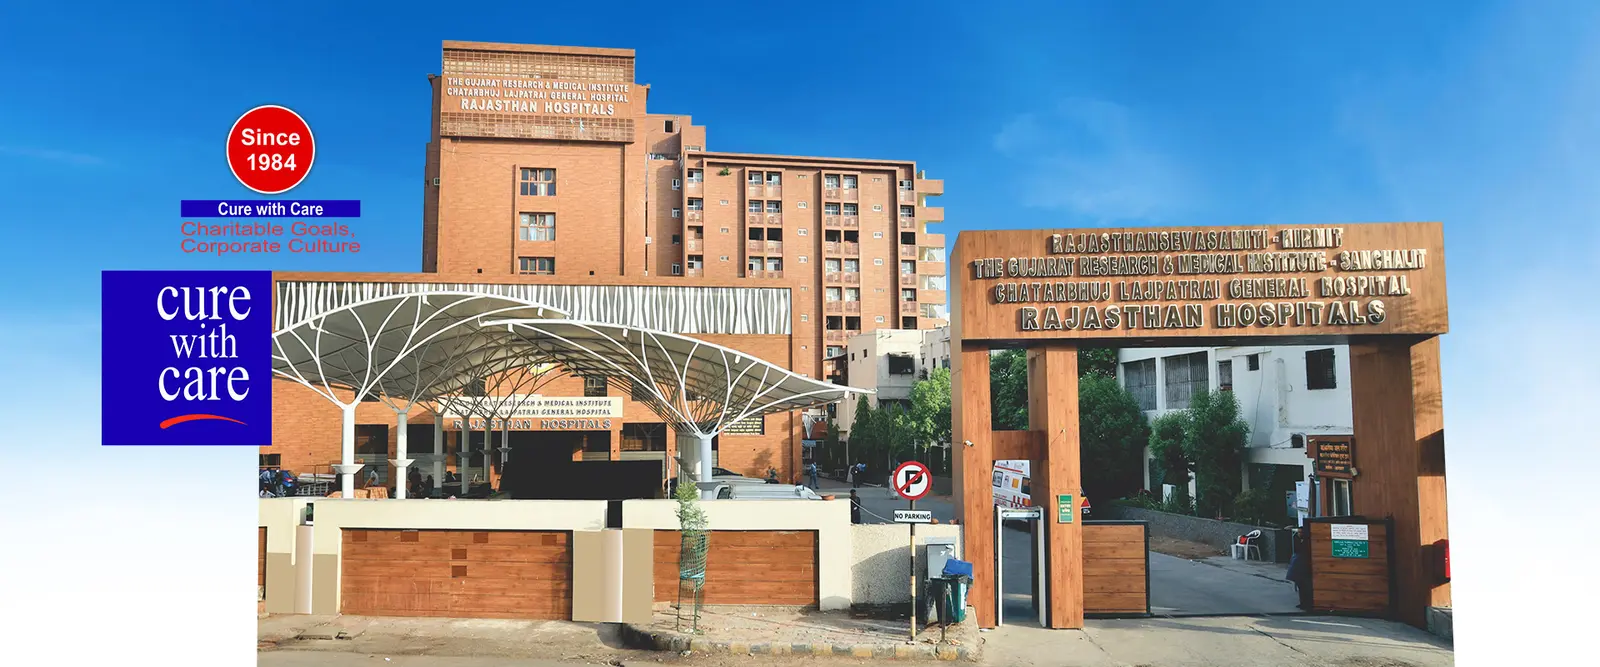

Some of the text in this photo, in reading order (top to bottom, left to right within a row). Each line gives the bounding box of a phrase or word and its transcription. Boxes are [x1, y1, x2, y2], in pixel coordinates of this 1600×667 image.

[447, 77, 629, 93] THE GUJARAT RESEARCH & MEDICAL INSTITUTE
[447, 88, 629, 103] CHATARBHUJ LAJPATRAI GENERAL HOSPITAL
[461, 99, 615, 115] RAJASTHAN HOSPITALS
[974, 258, 1004, 278] THE
[1008, 257, 1075, 277] GUJARAT
[1079, 255, 1159, 276] RESEARCH
[1163, 255, 1174, 274] &
[1178, 253, 1244, 274] MEDICAL
[1247, 251, 1327, 273] INSTITUTE
[1340, 248, 1427, 271] SANCHALIT
[995, 275, 1411, 303] CHATARBHUJ LAJPATRAI GENERAL HOSPITAL
[1021, 300, 1387, 330] RAJASTHAN HOSPITALS
[453, 419, 612, 429] RJASTAN HOSPITALS
